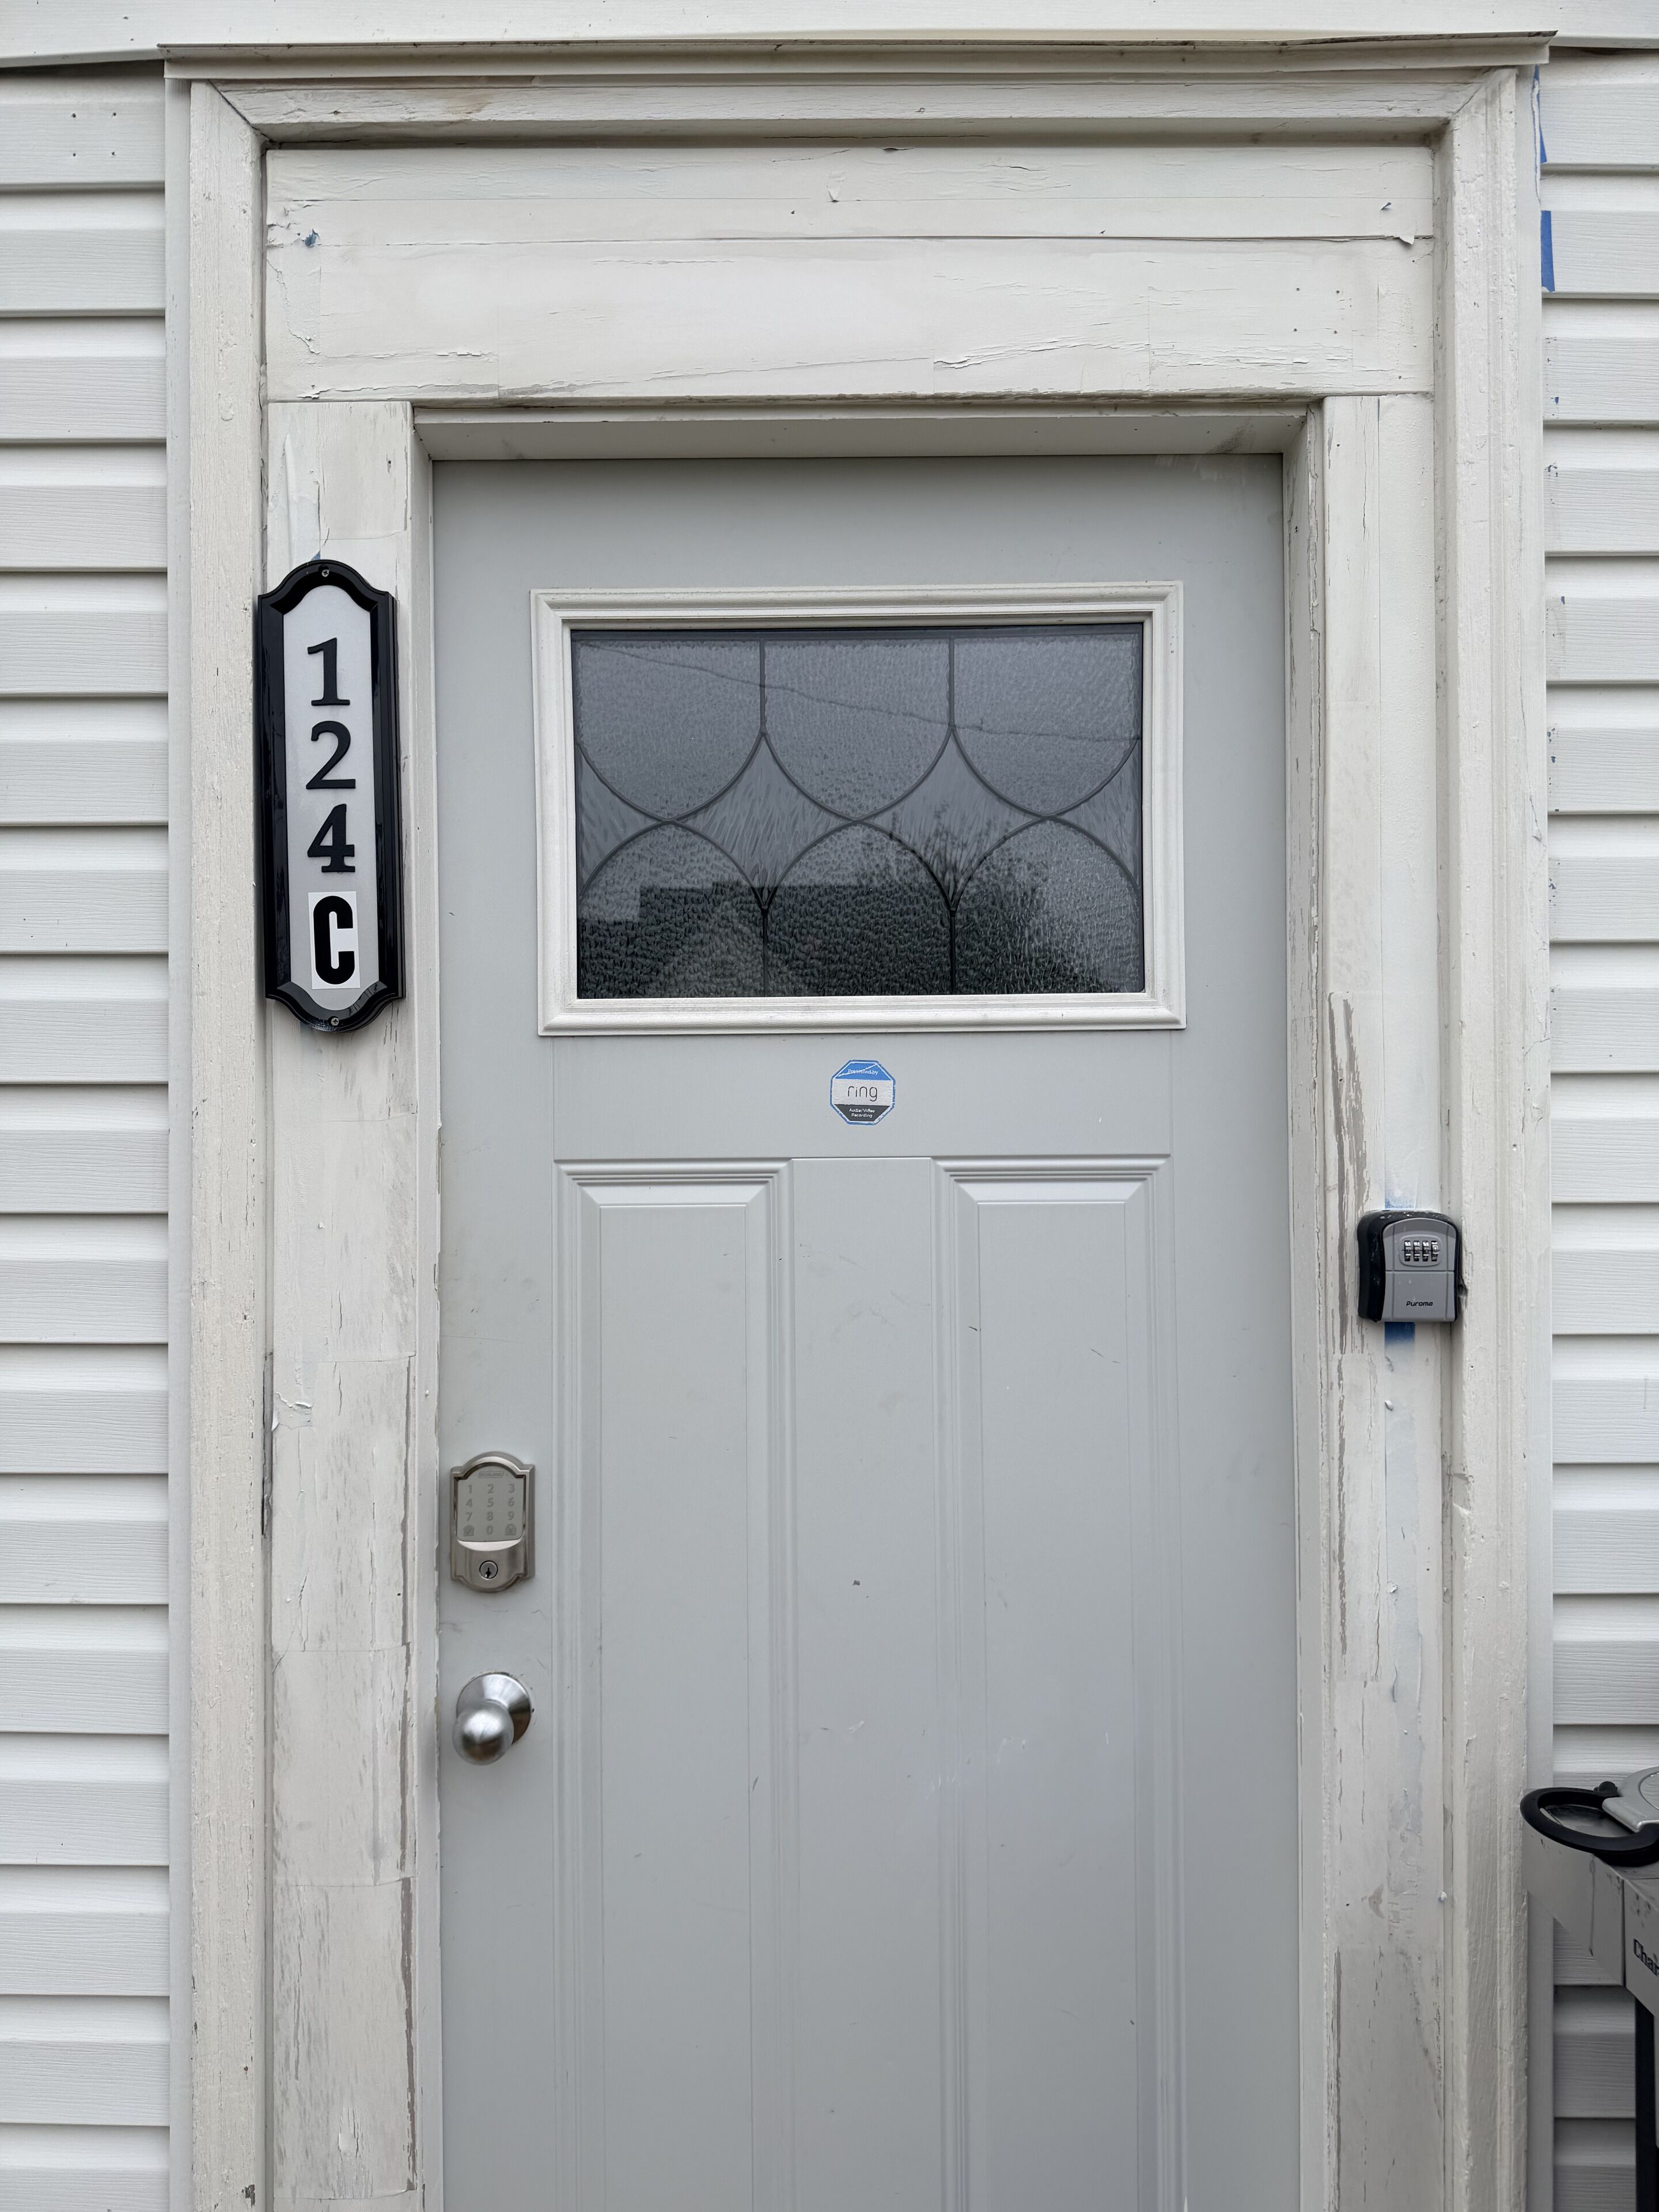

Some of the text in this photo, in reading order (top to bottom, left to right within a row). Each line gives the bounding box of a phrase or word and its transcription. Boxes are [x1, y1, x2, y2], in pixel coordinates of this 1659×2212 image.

[847, 1085, 877, 1101] ring
[467, 1483, 515, 1493] 1 2 3
[465, 1497, 514, 1508] 4 5 6
[465, 1511, 514, 1521] 7 8 9
[486, 1525, 493, 1535] 0
